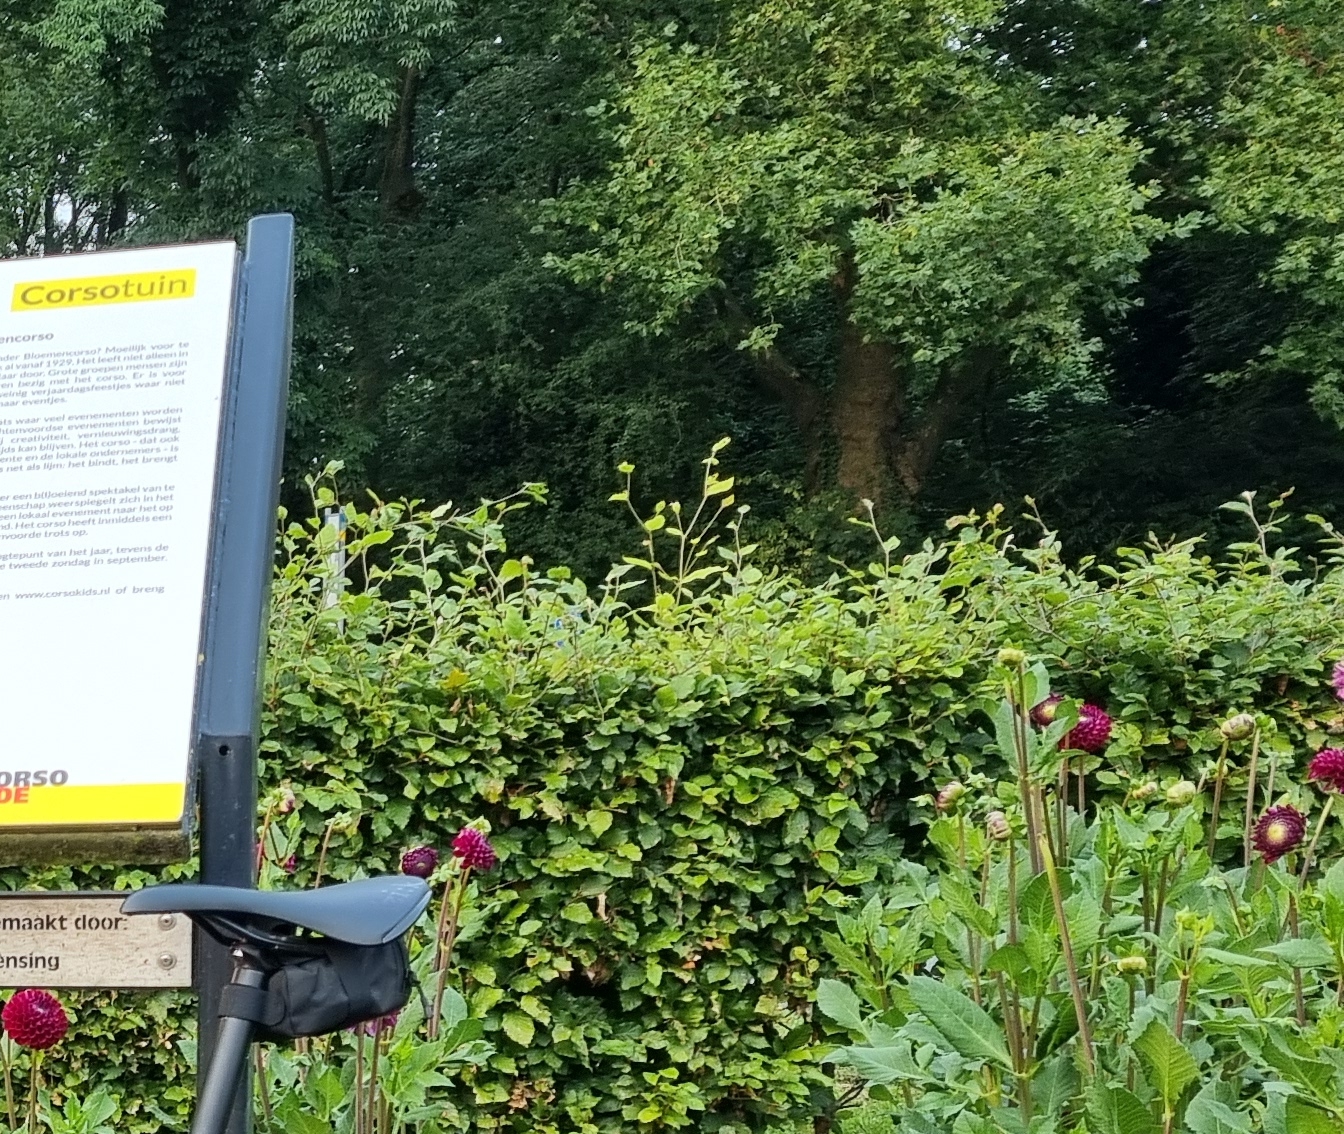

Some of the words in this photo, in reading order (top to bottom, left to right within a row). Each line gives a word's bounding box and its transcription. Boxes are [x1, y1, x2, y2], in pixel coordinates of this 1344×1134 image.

[20, 275, 188, 306] Corsotuin
[12, 493, 32, 501] een
[89, 485, 140, 497] spektakel
[164, 484, 175, 492] te
[48, 497, 116, 508] weerspiegelt
[119, 495, 140, 504] zich
[143, 494, 153, 502] in
[156, 493, 173, 501] het
[18, 510, 50, 519] lokaal
[51, 507, 110, 517] evenement
[139, 504, 156, 512] het
[159, 504, 173, 512] op
[15, 521, 34, 529] Het
[67, 517, 96, 526] heeft
[97, 514, 150, 525] inmiddels
[151, 514, 172, 522] een
[69, 548, 87, 556] het
[116, 546, 152, 554] tevens
[154, 543, 169, 552] de
[8, 560, 49, 569] tweede
[51, 558, 91, 567] zondag
[93, 557, 104, 565] in
[115, 586, 127, 594] of
[132, 585, 165, 594] breng
[74, 914, 128, 931] door:
